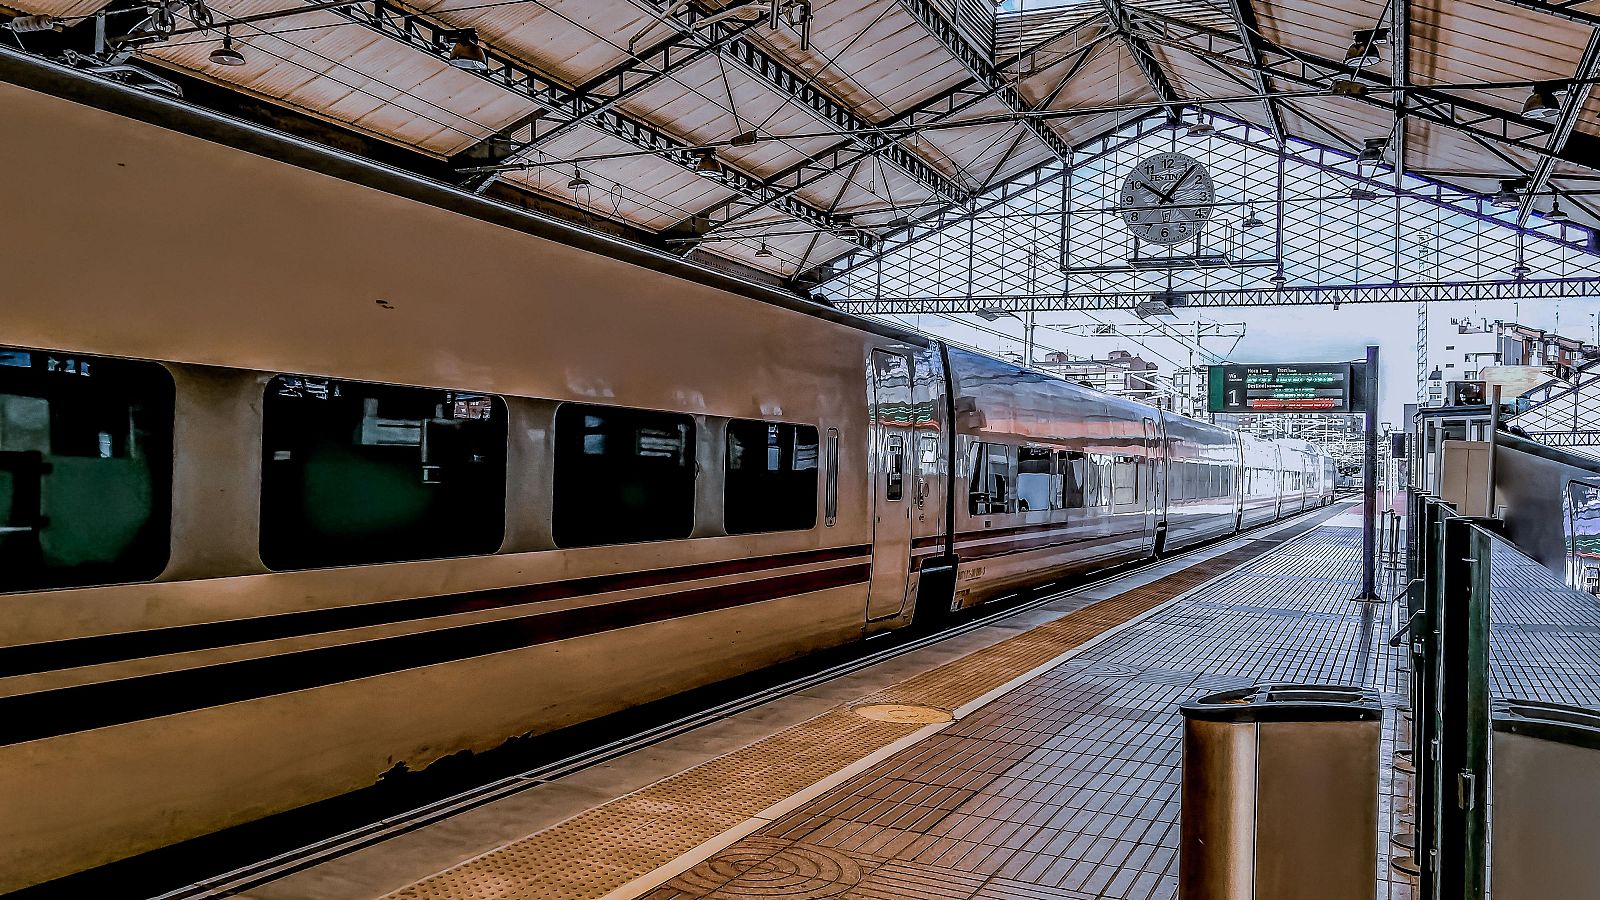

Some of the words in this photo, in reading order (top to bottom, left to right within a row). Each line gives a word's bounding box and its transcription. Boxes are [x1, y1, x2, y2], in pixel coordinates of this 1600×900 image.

[1162, 159, 1174, 168] 12
[1144, 164, 1154, 174] 11
[1194, 175, 1202, 184] 2
[1130, 180, 1142, 190] 10
[1126, 196, 1134, 205] 9
[1199, 192, 1207, 201] 3
[1130, 212, 1138, 221] 8
[1194, 208, 1202, 218] 4
[1145, 224, 1152, 234] 7
[1179, 223, 1186, 232] 5
[1161, 228, 1168, 237] 6
[1228, 389, 1240, 406] 1
